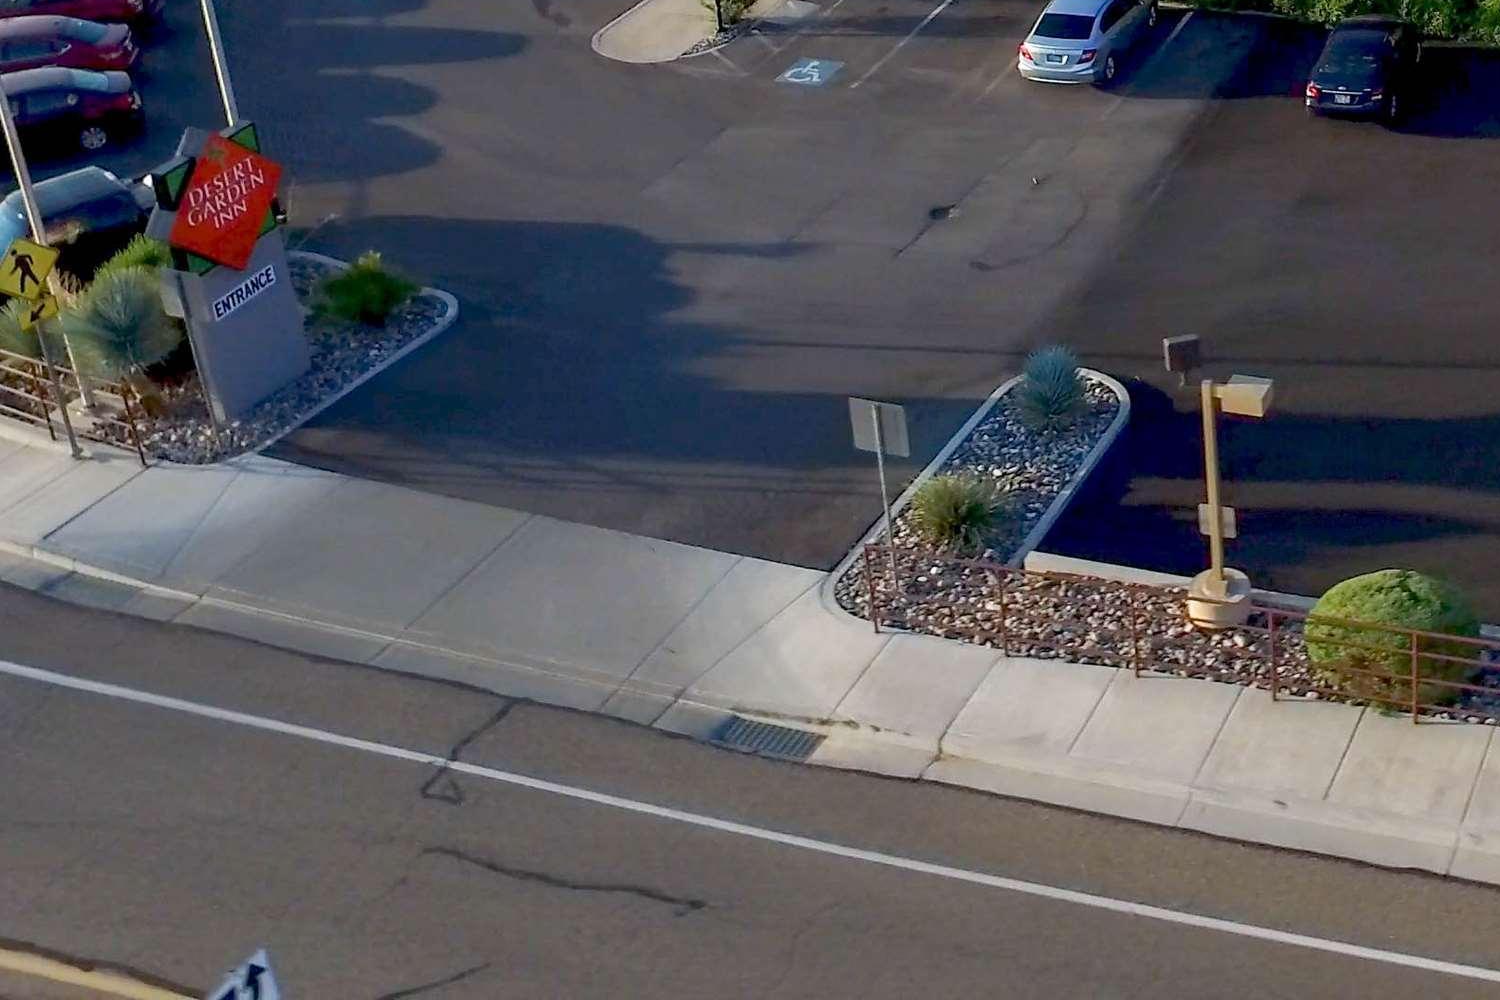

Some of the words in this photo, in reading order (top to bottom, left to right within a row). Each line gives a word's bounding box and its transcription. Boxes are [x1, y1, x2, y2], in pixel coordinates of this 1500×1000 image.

[188, 157, 255, 207] DESERT
[188, 169, 264, 226] GARDEN
[214, 200, 247, 228] INN
[214, 267, 275, 317] ENTRANCE
